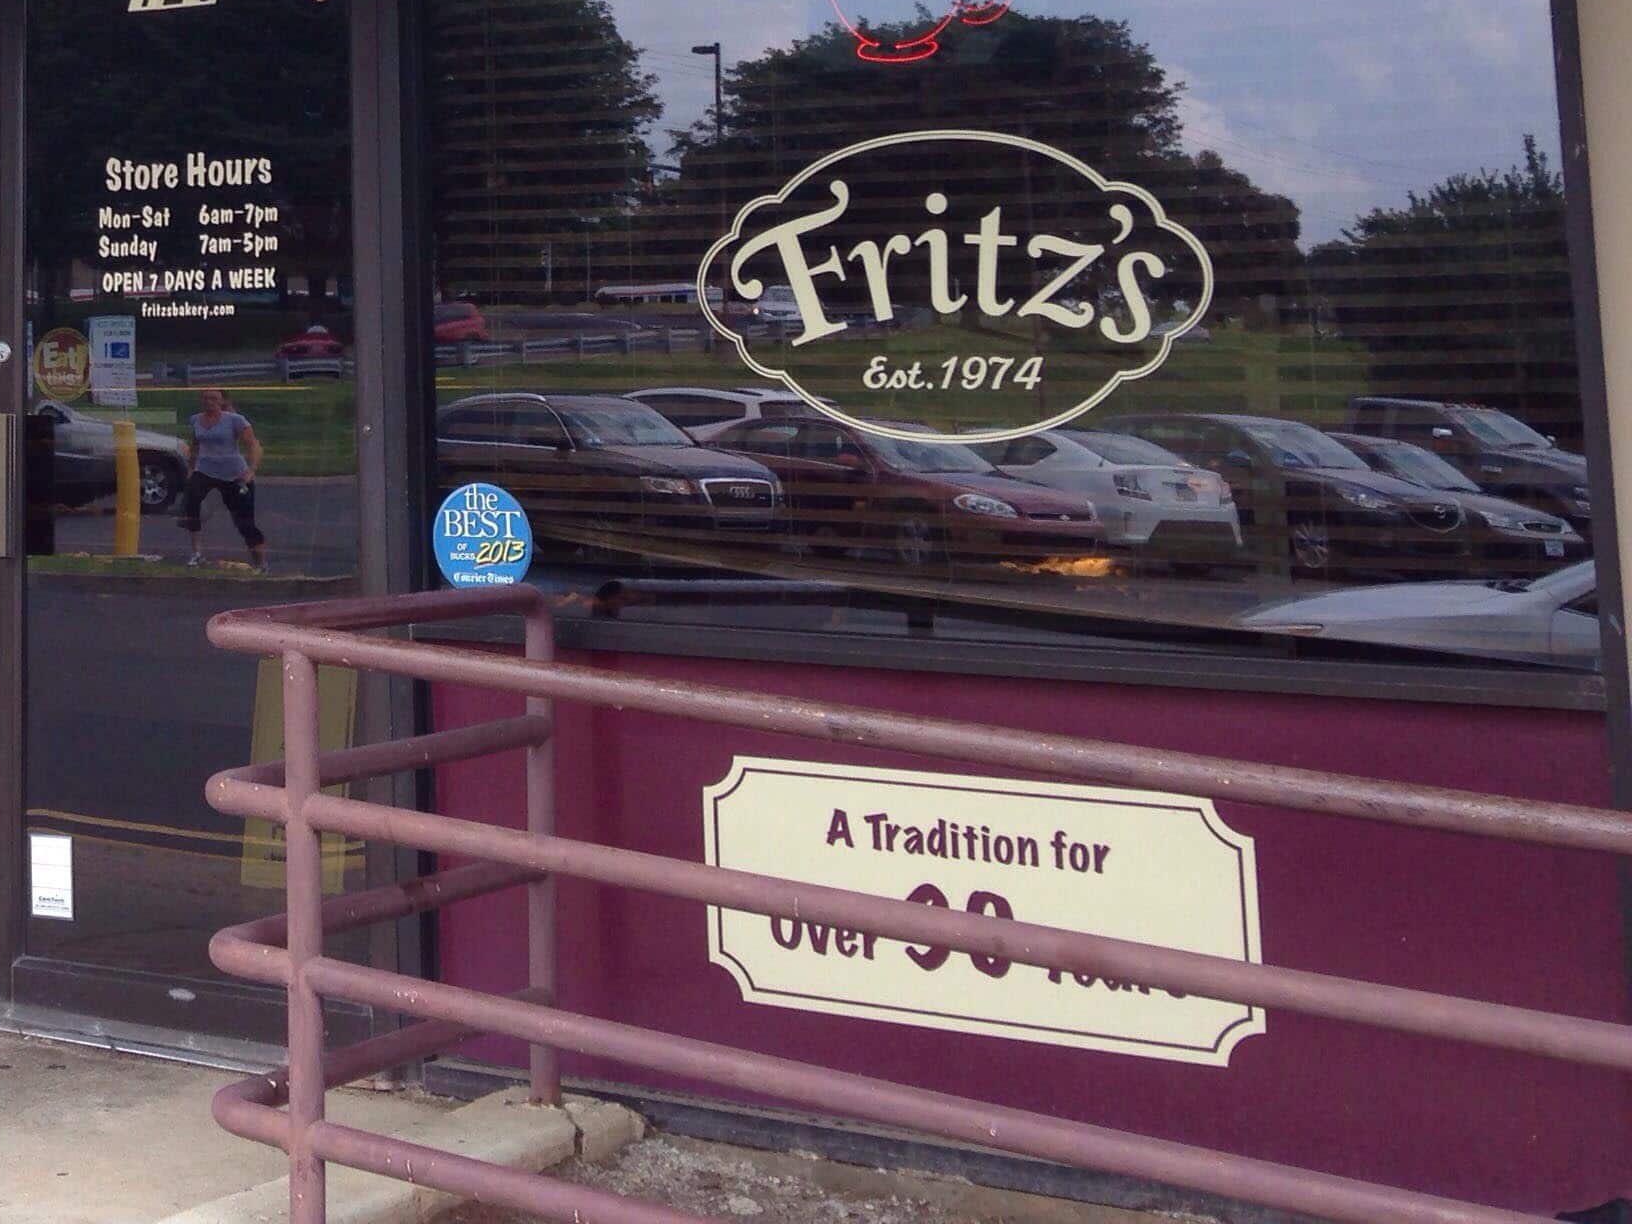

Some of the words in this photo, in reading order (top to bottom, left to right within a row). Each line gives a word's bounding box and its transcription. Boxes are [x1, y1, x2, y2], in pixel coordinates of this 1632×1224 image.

[105, 156, 179, 192] Store
[186, 151, 272, 188] Hours
[98, 205, 171, 229] Mon-Sat
[198, 203, 279, 229] 6am-7pm
[98, 234, 158, 262] Sunday
[198, 232, 279, 258] 7am-5pm
[102, 270, 144, 293] OPEN
[148, 273, 159, 292] 7
[164, 269, 206, 291] DAYS
[211, 269, 223, 290] A
[228, 267, 276, 289] WEEK
[730, 180, 1166, 350] Fritz's
[141, 301, 235, 320] fritzsbakery.com
[863, 354, 1043, 392] Est.1974
[464, 483, 499, 511] the
[443, 509, 521, 539] BEST
[475, 540, 526, 564] 2013
[825, 808, 855, 849] A
[863, 812, 1040, 868] Tradition
[1050, 830, 1112, 875] for
